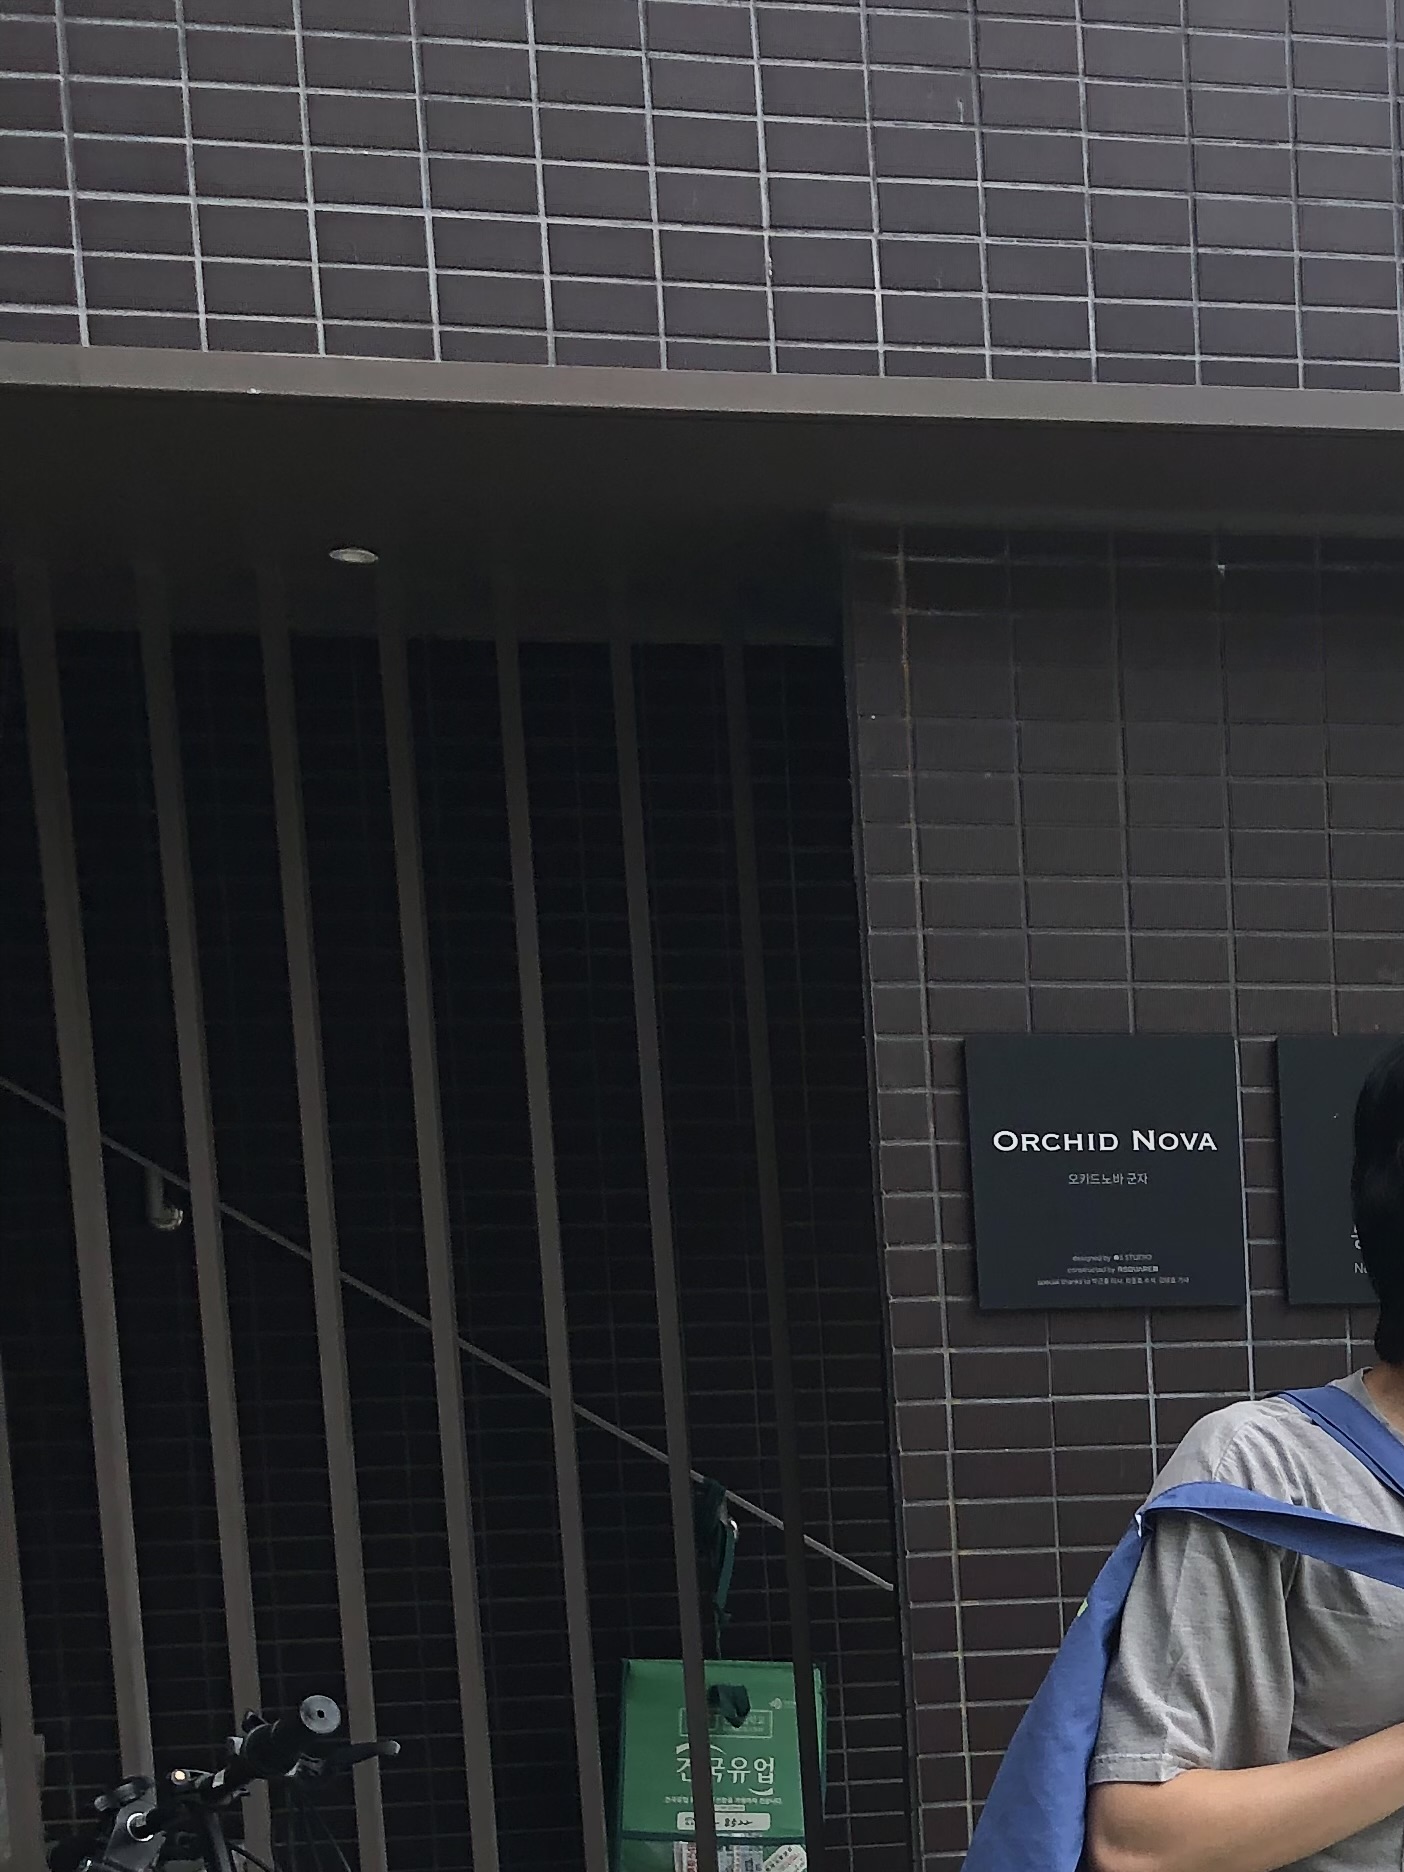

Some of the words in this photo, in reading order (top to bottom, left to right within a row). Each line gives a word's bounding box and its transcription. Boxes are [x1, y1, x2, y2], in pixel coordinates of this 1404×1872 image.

[993, 1130, 1120, 1152] ORCHID
[1131, 1129, 1218, 1151] NOVA
[1126, 1172, 1148, 1185] 군자
